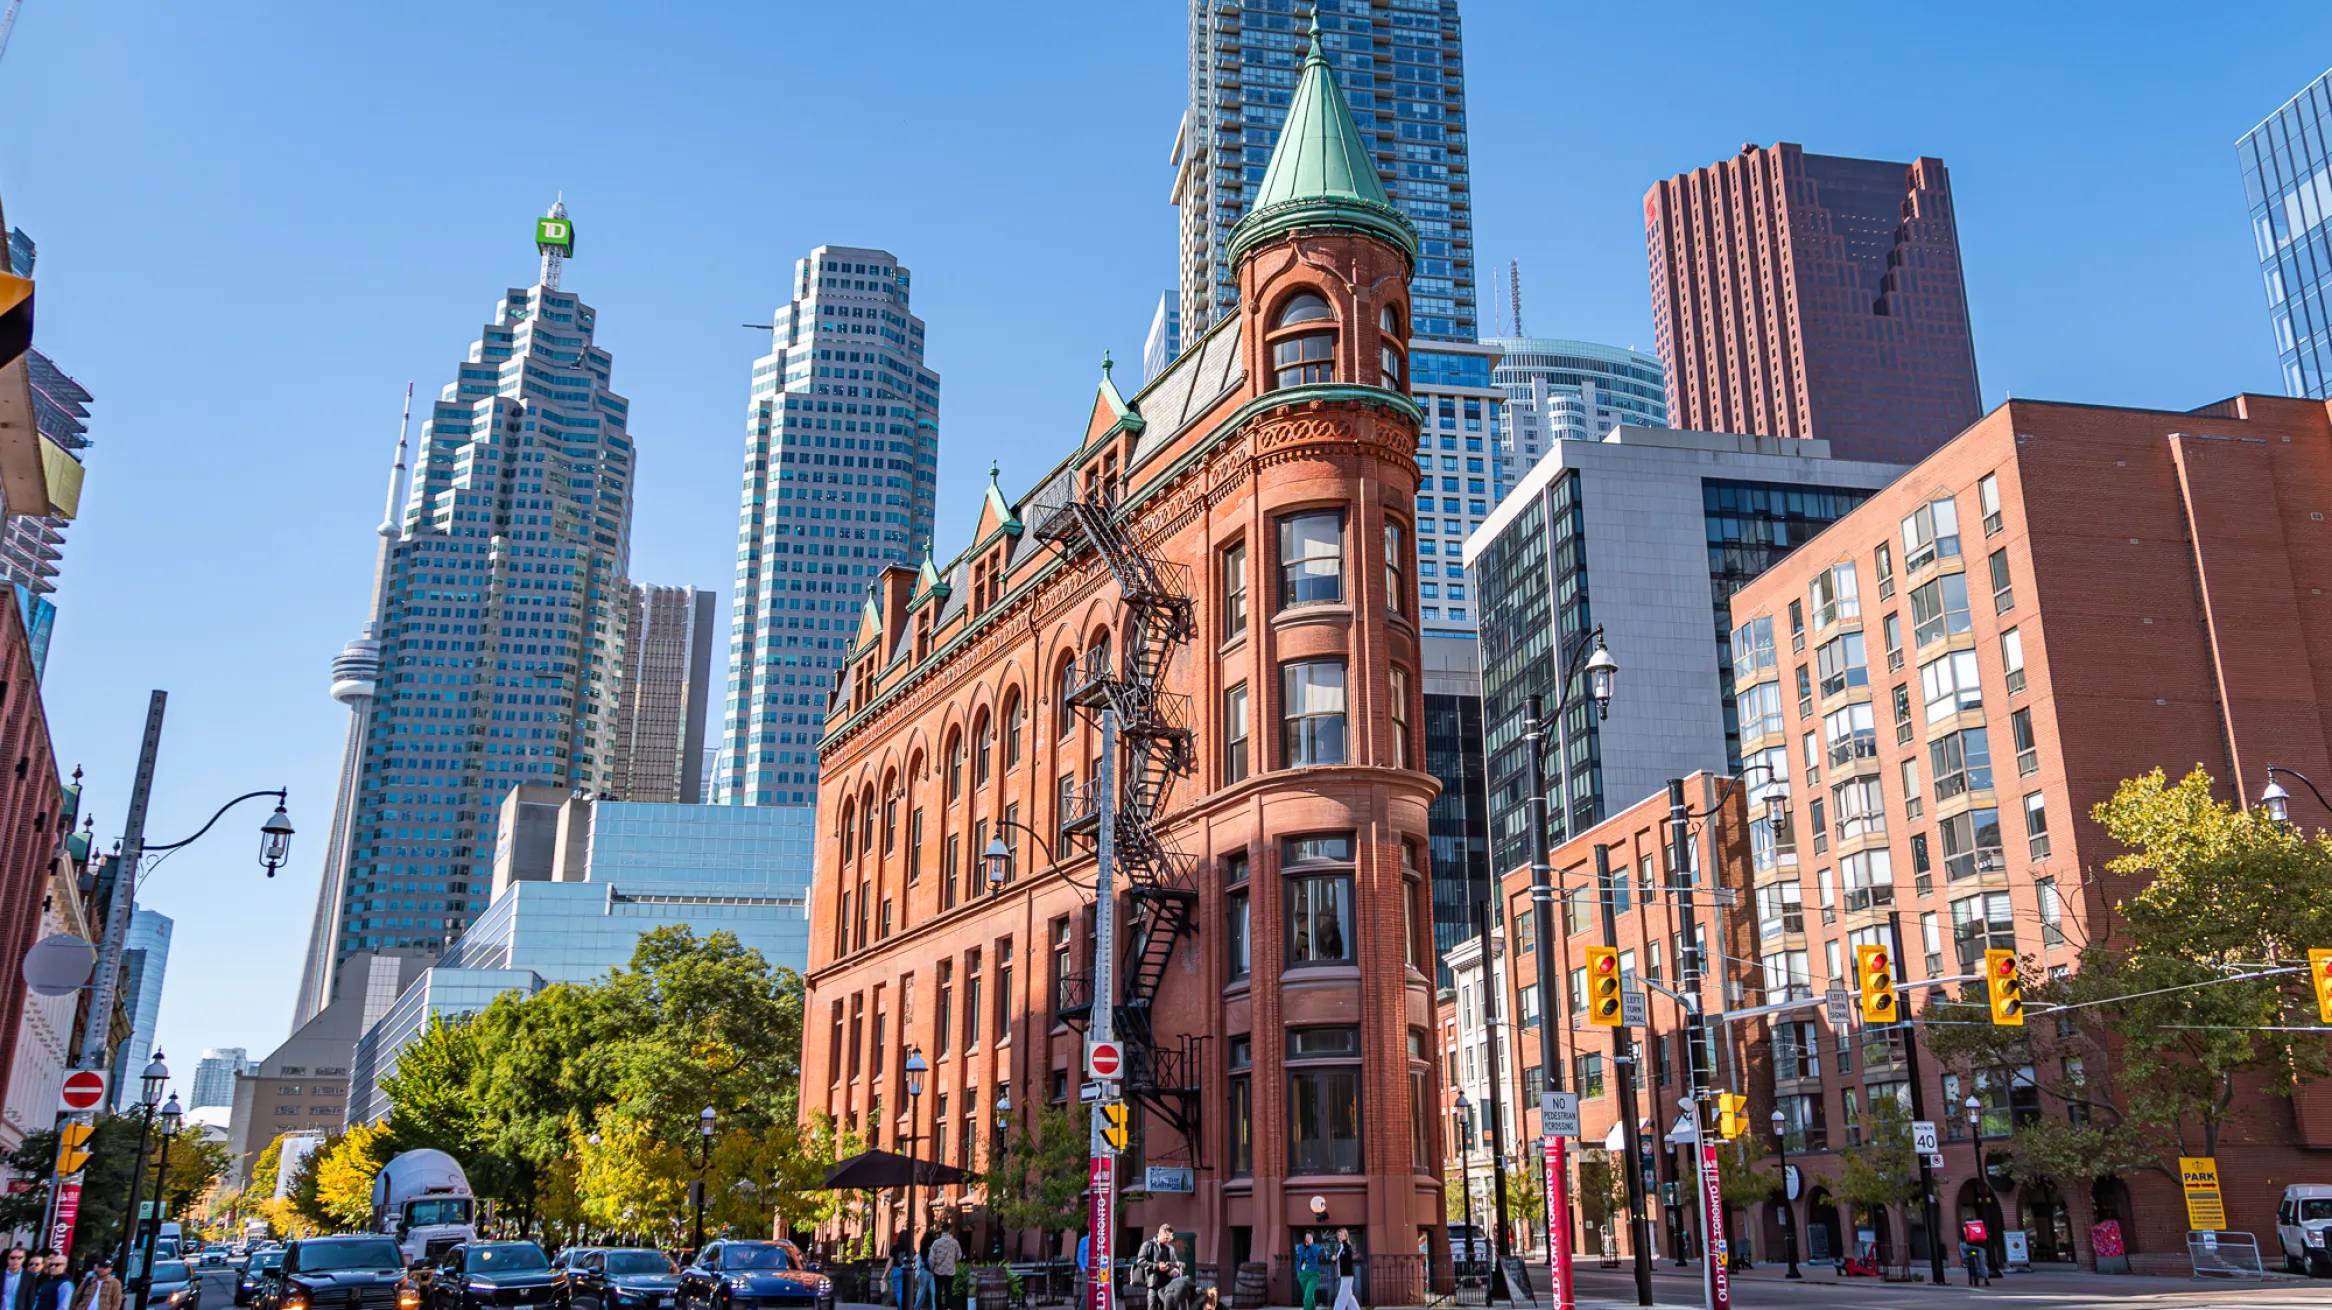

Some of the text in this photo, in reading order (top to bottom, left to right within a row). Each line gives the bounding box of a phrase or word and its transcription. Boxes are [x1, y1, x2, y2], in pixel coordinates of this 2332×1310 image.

[541, 222, 566, 238] TD
[1626, 996, 1640, 1004] LEFT
[1552, 1098, 1566, 1109] NO
[1544, 1112, 1576, 1120] PEDESTRIAN
[1546, 1122, 1574, 1131] CROSSING
[1917, 1135, 1935, 1149] 40
[2184, 1172, 2216, 1181] PARK
[1710, 1185, 1721, 1236] TORONTO
[1096, 1198, 1107, 1250] TORONTO
[1546, 1168, 1562, 1310] OLD TOWN TORONTO
[1717, 1275, 1728, 1302] OLD
